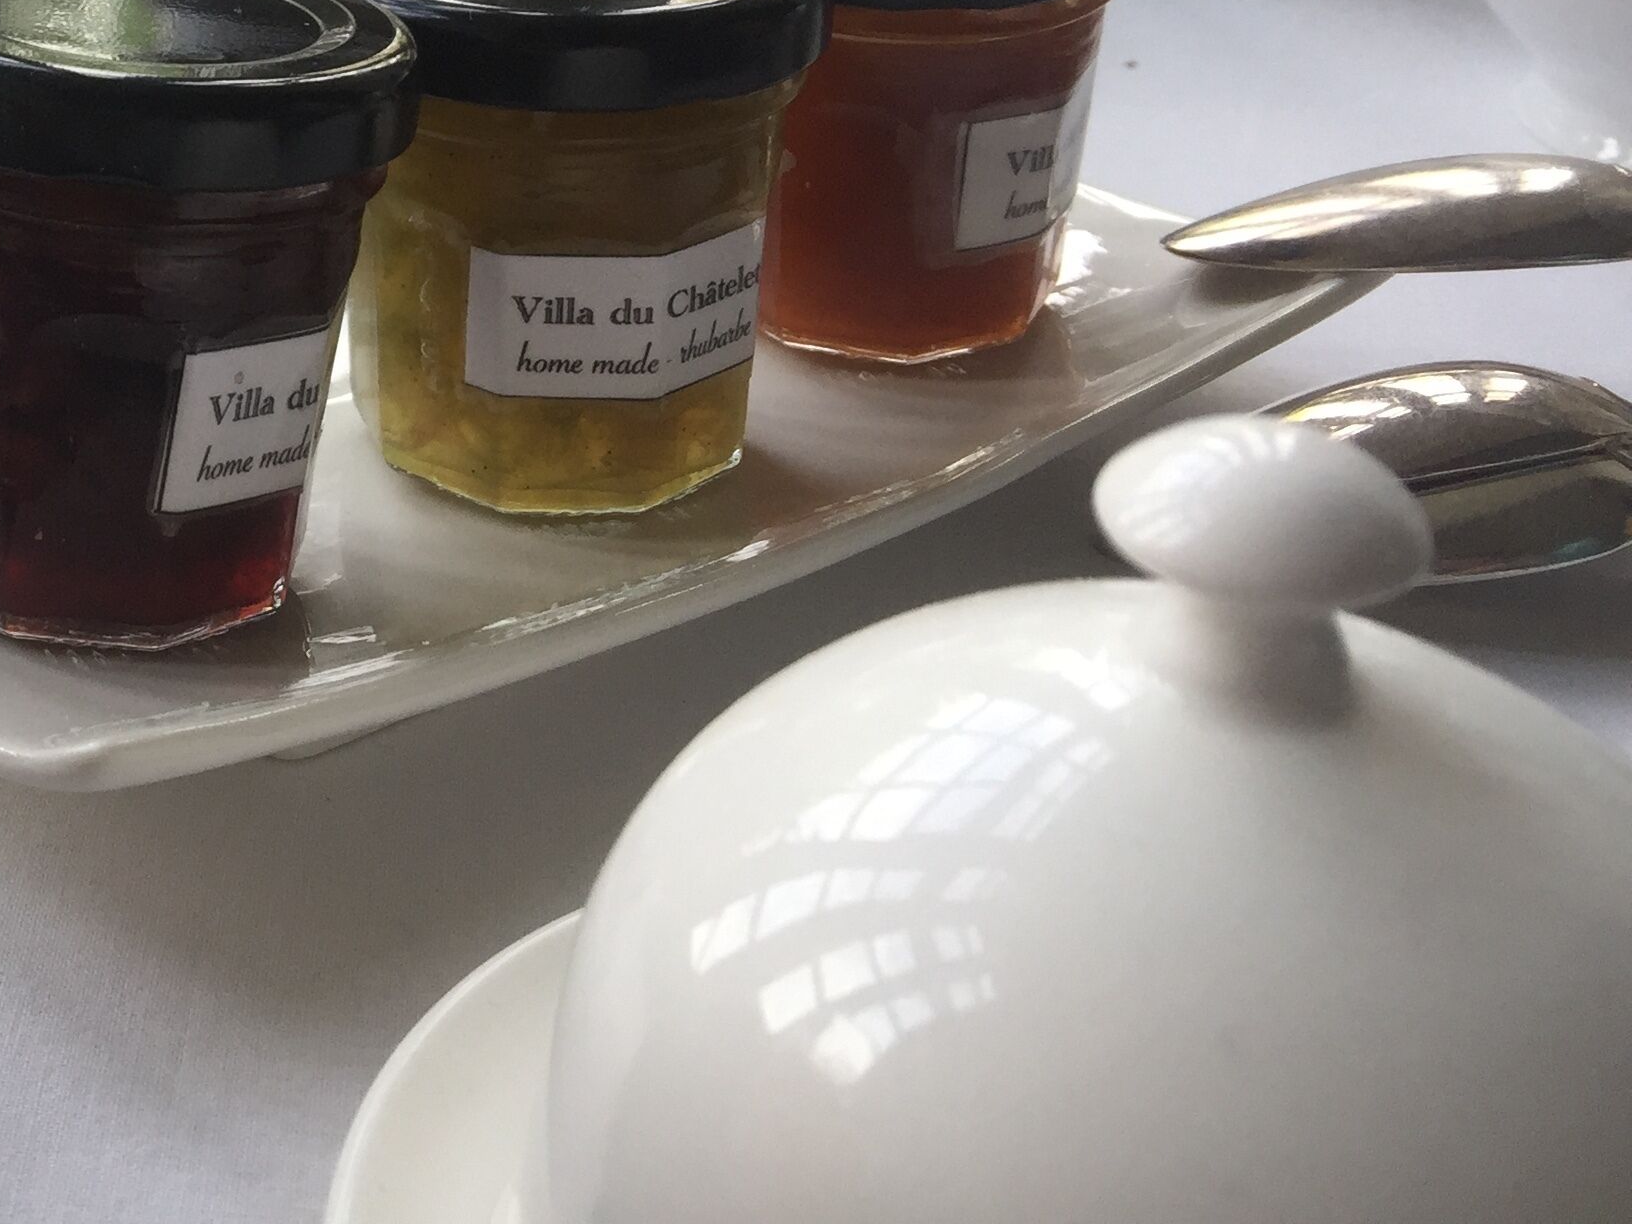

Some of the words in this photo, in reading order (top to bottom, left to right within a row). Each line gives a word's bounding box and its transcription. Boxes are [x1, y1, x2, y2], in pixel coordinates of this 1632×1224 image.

[1007, 144, 1055, 176] Vill
[510, 294, 595, 326] Villa
[608, 297, 655, 326] du
[516, 340, 584, 375] home
[591, 341, 660, 375] made
[679, 306, 752, 365] rhubarbe
[208, 386, 276, 426] Villa
[286, 377, 320, 410] du
[195, 444, 253, 483] home
